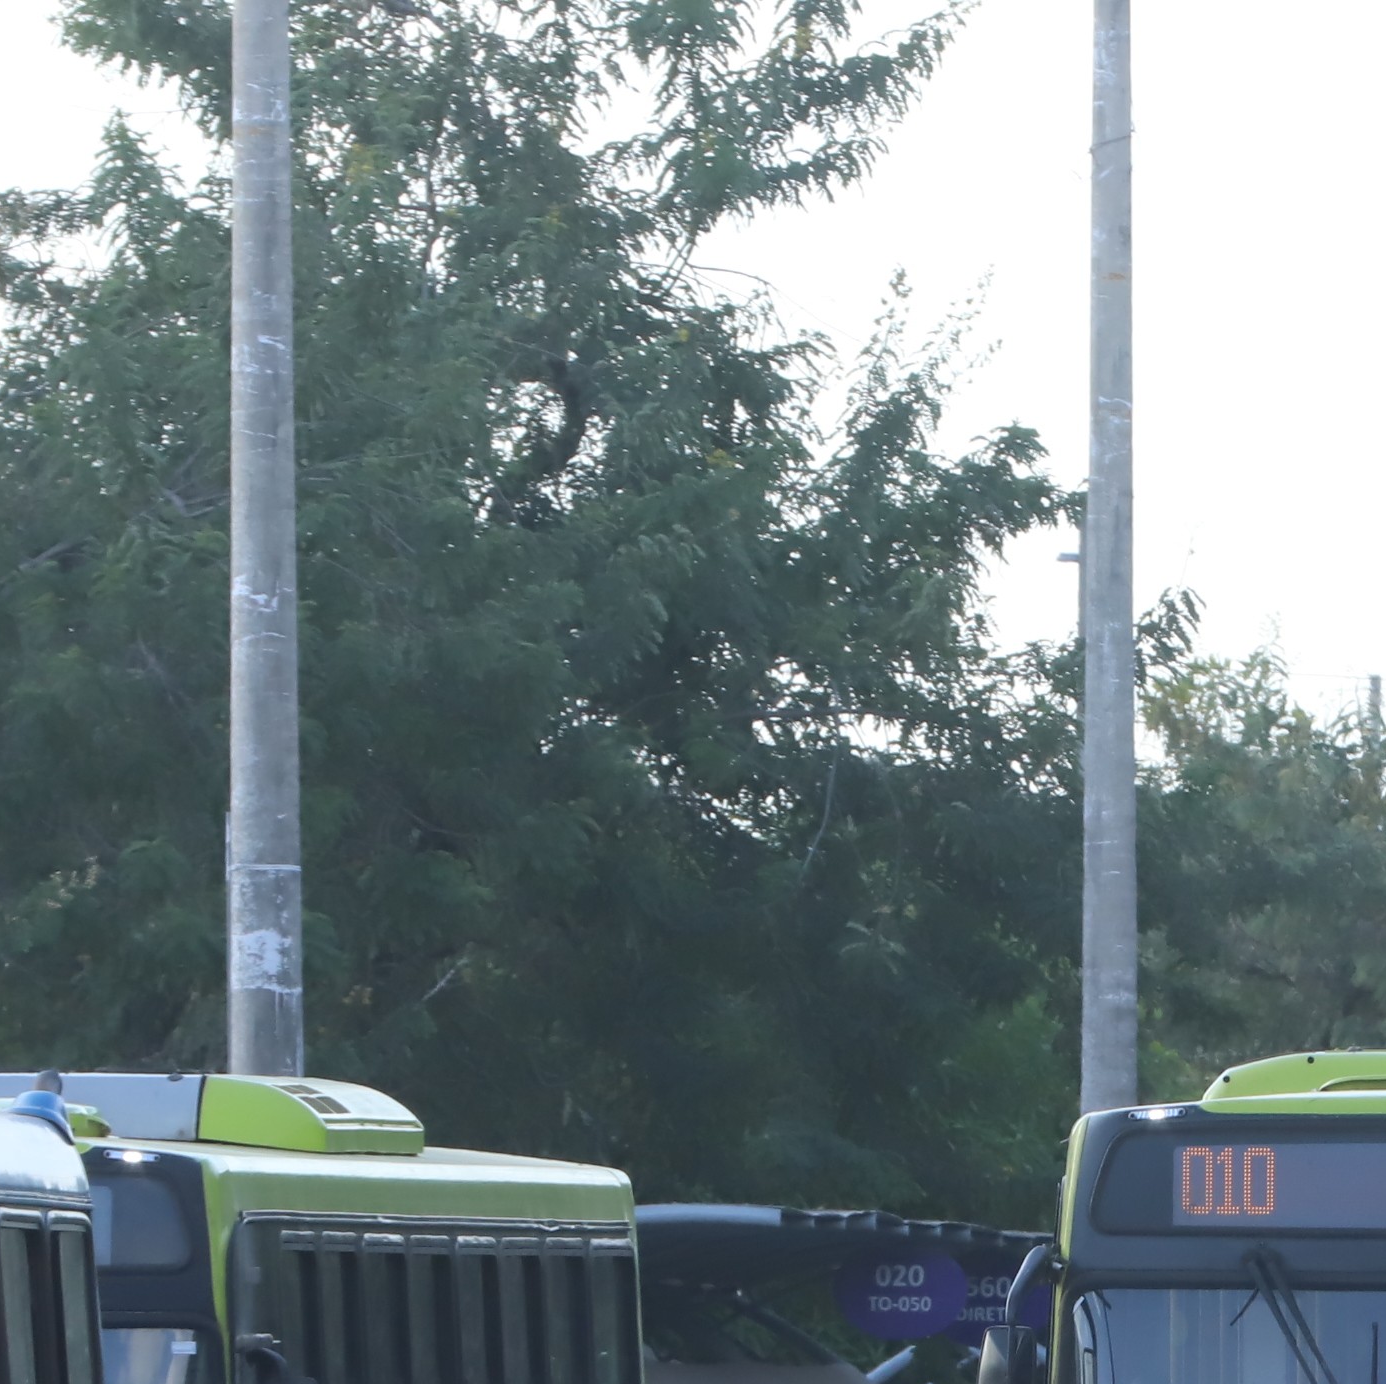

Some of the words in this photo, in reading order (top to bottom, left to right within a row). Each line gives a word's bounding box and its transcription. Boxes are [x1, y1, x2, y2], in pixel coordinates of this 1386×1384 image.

[1182, 1147, 1276, 1215] 010
[875, 1264, 926, 1288] 020
[869, 1296, 933, 1313] TO-050
[956, 1306, 1007, 1322] DIRET
